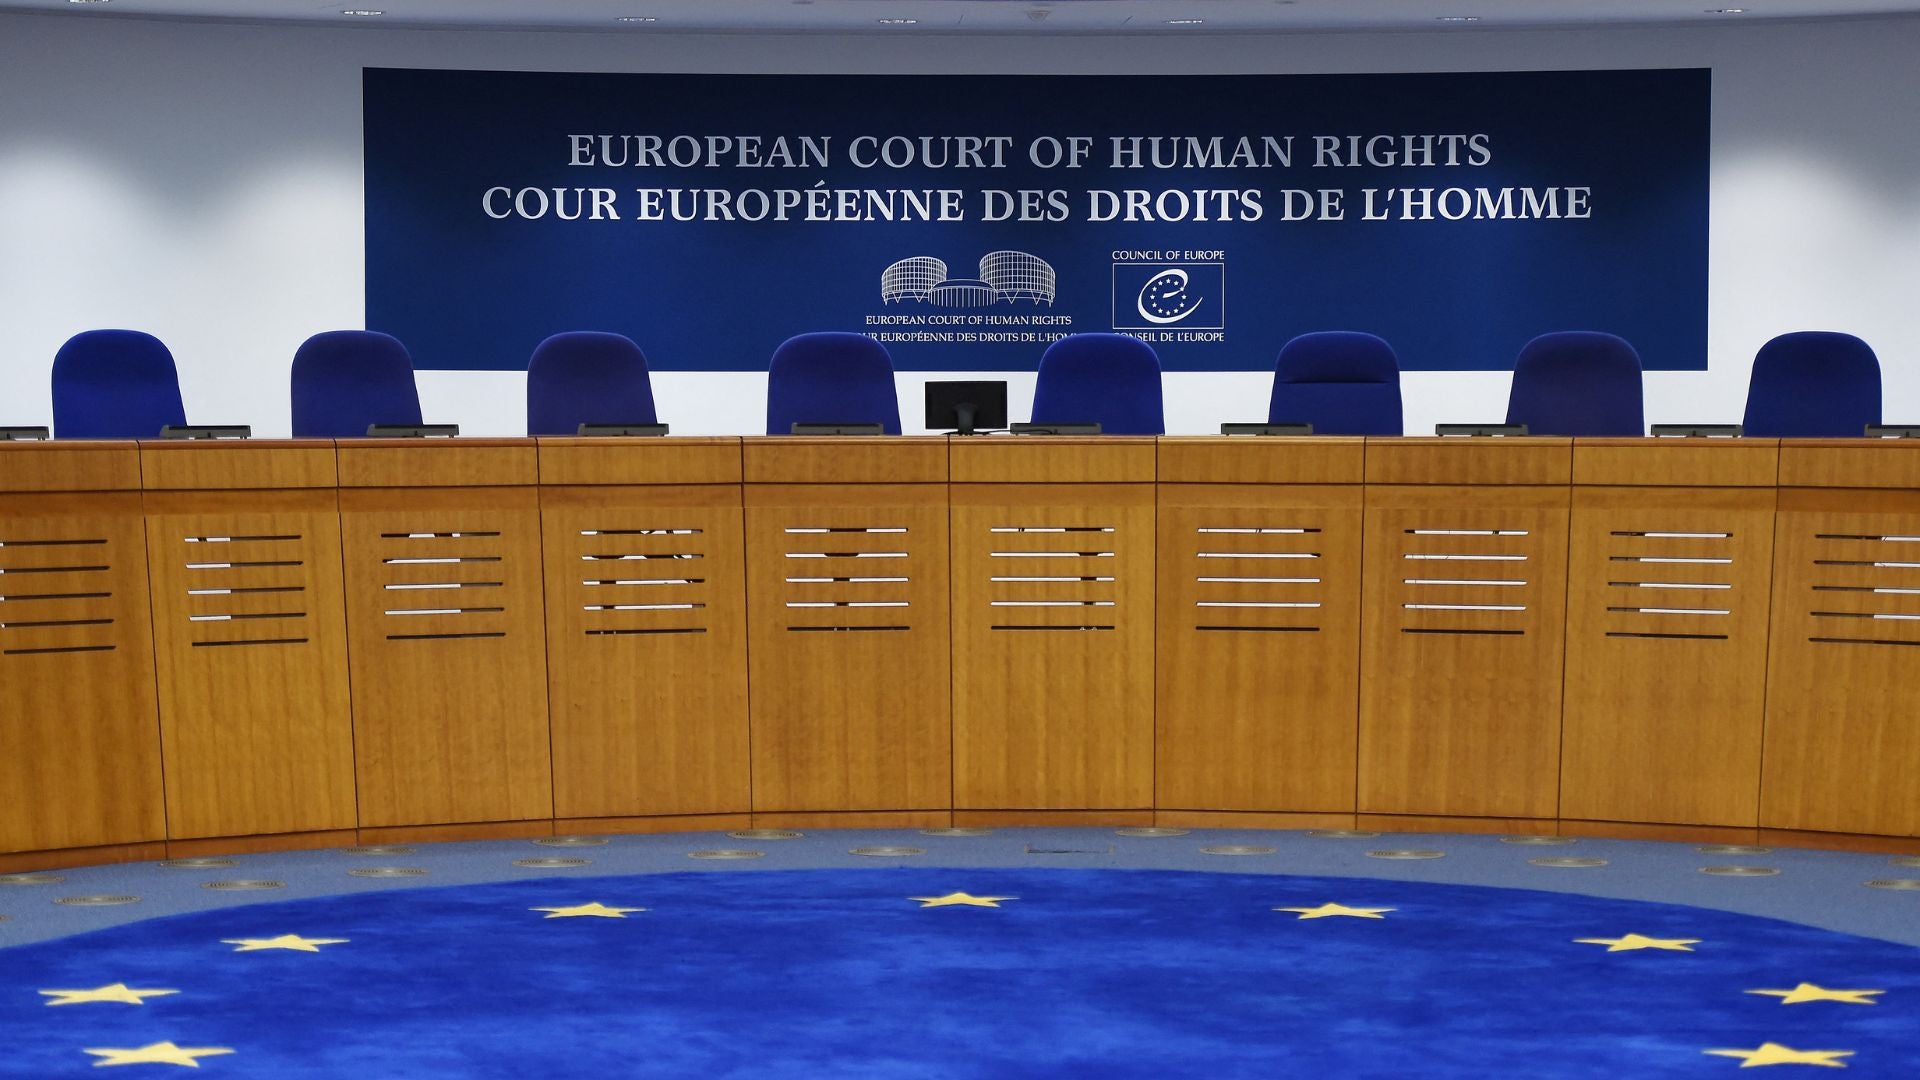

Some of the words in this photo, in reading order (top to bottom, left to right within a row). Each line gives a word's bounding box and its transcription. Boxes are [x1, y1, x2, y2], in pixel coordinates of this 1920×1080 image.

[568, 134, 832, 168] EUROPEAN
[848, 135, 1013, 169] COURT
[1029, 136, 1093, 169] OF
[1109, 135, 1295, 169] HUMAN
[1312, 133, 1492, 168] RIGHTS
[482, 186, 621, 221] COUR
[636, 180, 965, 222] EUROPÉENNE
[980, 189, 1070, 222] DES
[1086, 188, 1264, 222] DROITS
[1280, 188, 1345, 222] DE
[1361, 186, 1592, 221] L'HOMME
[1111, 250, 1162, 260] COUNCIL
[1166, 250, 1181, 260] OF
[1184, 250, 1225, 260] EUROPE
[865, 315, 926, 325] EUROPEAN
[928, 315, 967, 325] COURT
[968, 315, 983, 325] OF
[985, 315, 1029, 325] HUMAN
[1031, 315, 1072, 325] RIGHTS
[880, 331, 954, 342] EUROPÉENNE
[956, 332, 977, 342] DES
[979, 332, 1019, 342] DROITS
[1021, 332, 1036, 342] DE
[1160, 332, 1174, 342] DE
[1177, 332, 1225, 342] L'EUROPE
